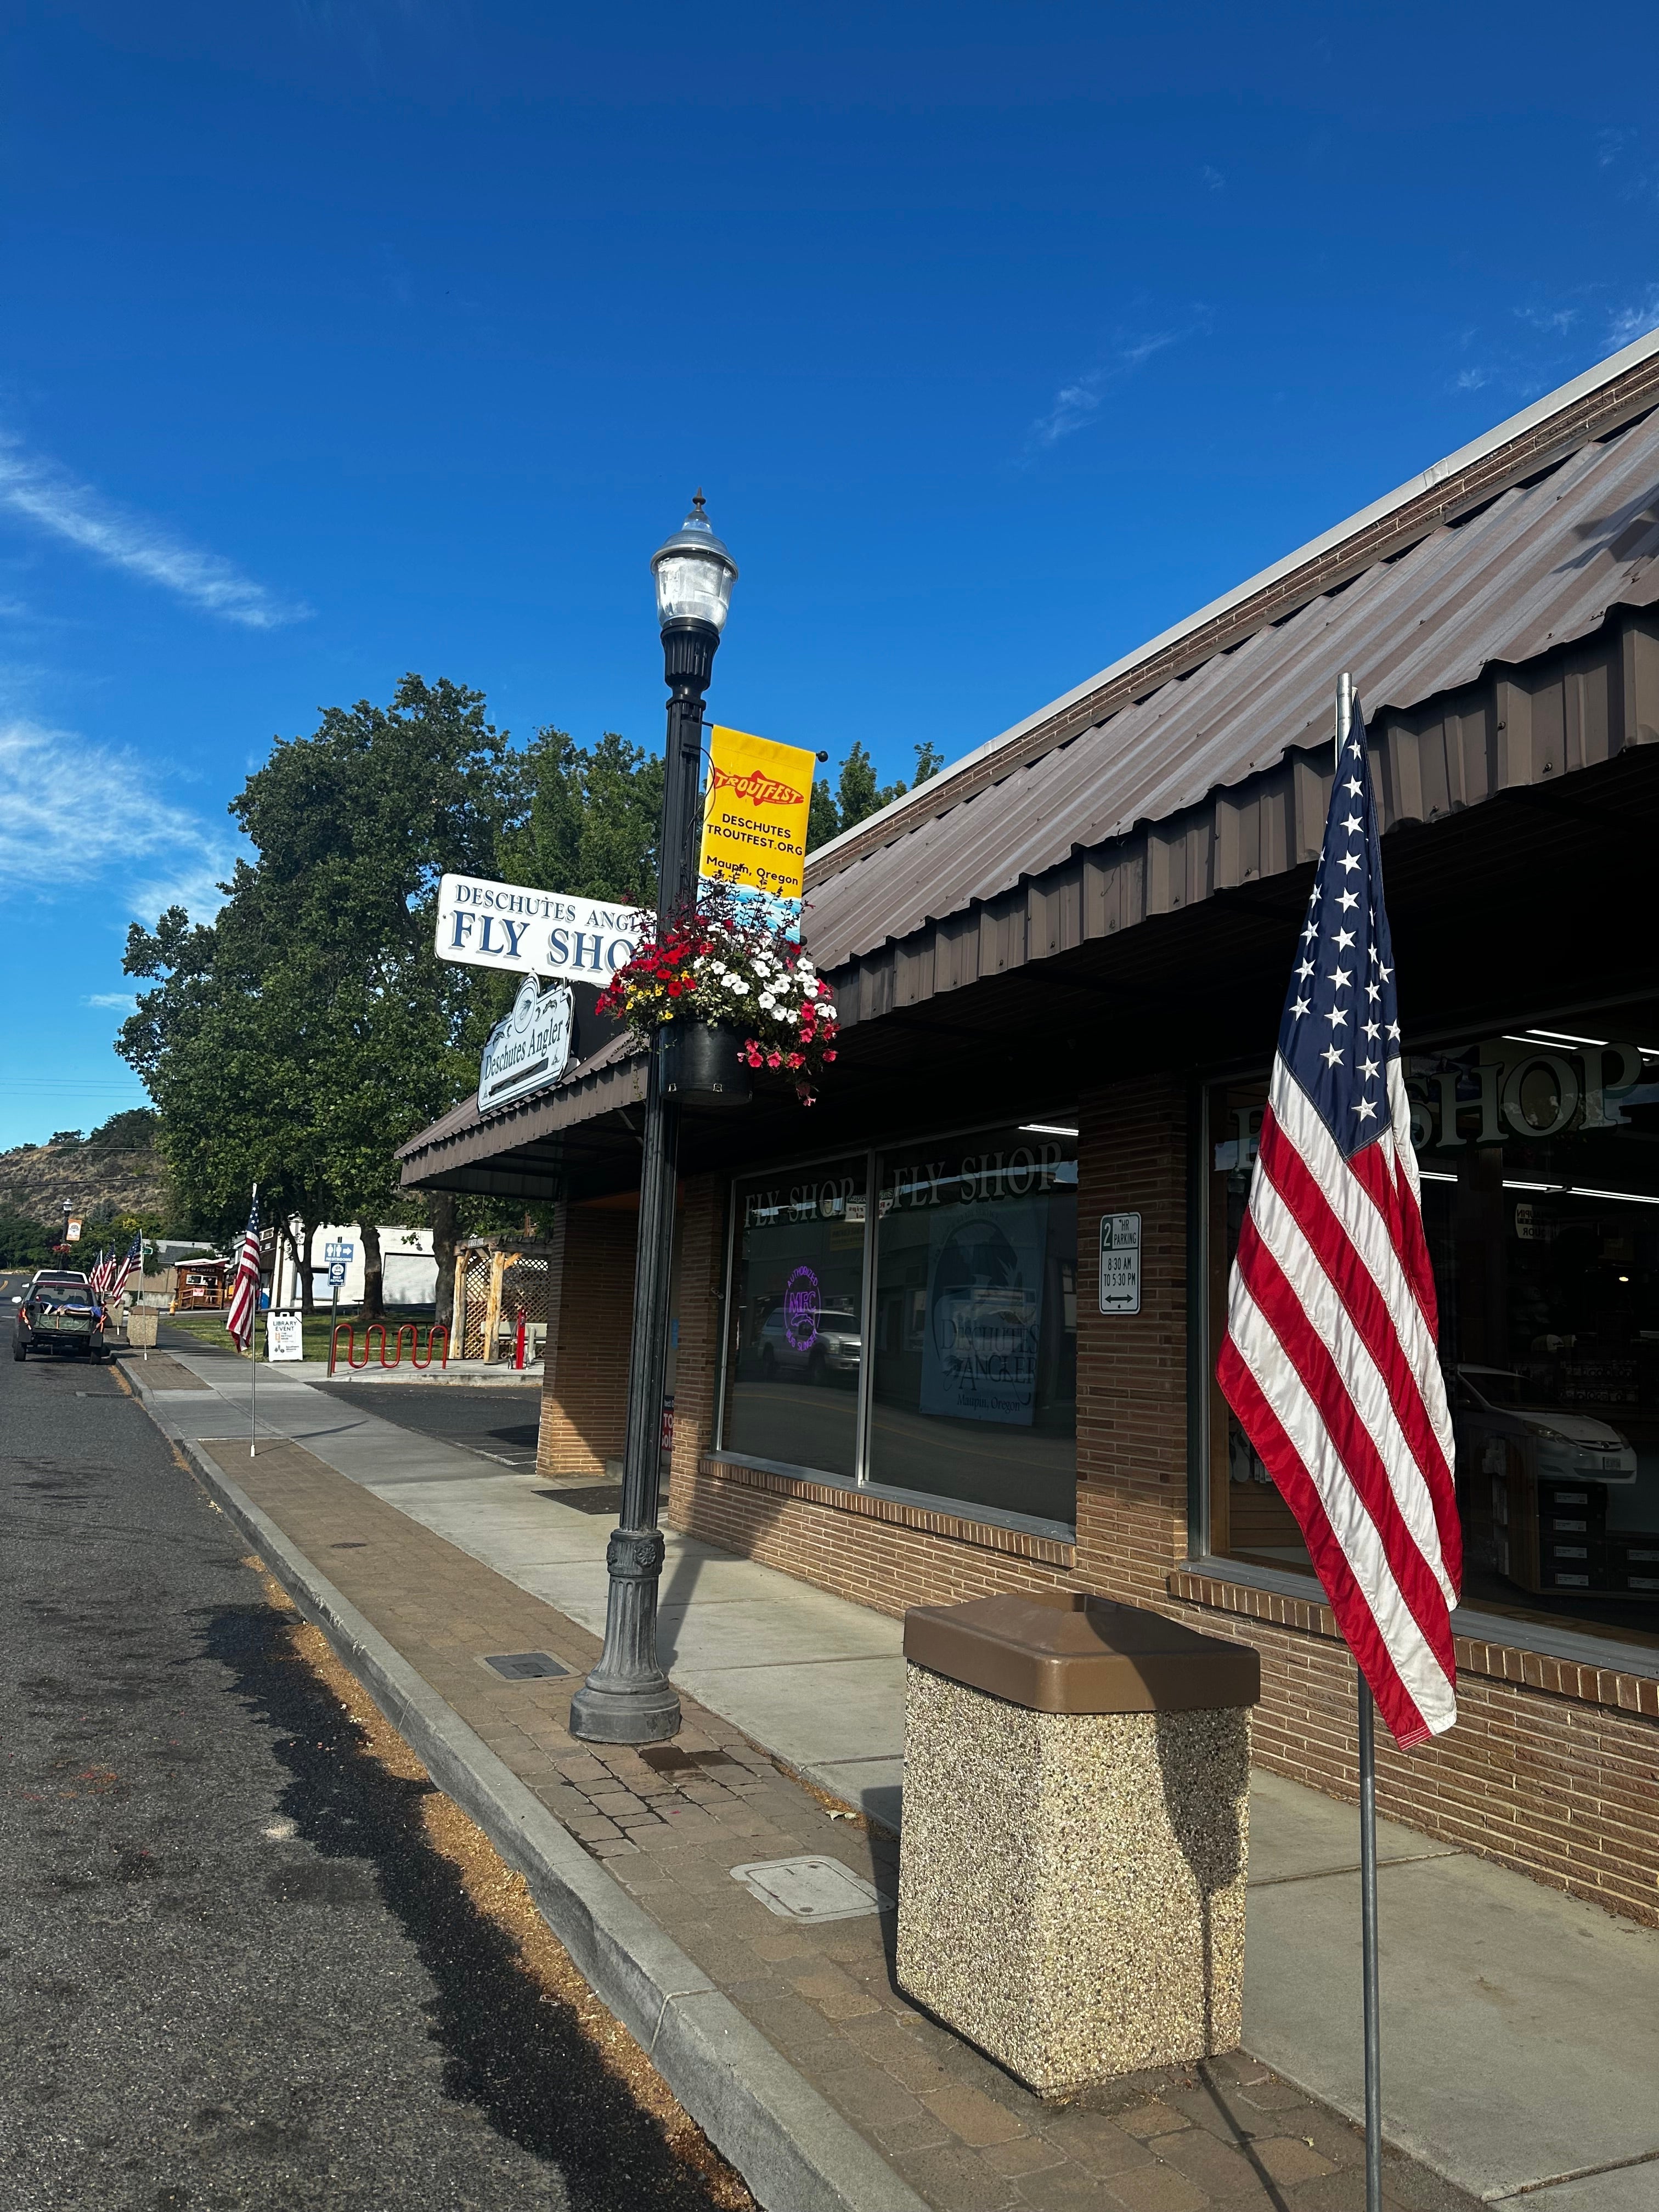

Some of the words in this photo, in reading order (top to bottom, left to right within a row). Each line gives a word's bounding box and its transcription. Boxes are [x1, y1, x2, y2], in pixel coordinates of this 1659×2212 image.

[715, 772, 802, 804] TROUTFEST
[707, 824, 803, 856] TROUTFEST.ORG
[722, 813, 791, 838] DESCHUTES
[757, 867, 798, 885] Oregon
[456, 884, 576, 922] DESCHUTES
[587, 909, 642, 934] ANGL
[450, 910, 530, 958] FLY
[549, 928, 638, 972] SHO
[484, 1041, 525, 1081] Deschutes
[528, 1017, 563, 1058] Angler
[893, 1161, 947, 1208] FLY
[961, 1142, 1063, 1201] SHOP
[744, 1191, 780, 1228] FLY
[789, 1177, 855, 1222] SHOP
[1103, 1222, 1111, 1246] 2
[1121, 1219, 1129, 1231] HR
[1114, 1232, 1137, 1245] PARKING
[1104, 1274, 1110, 1286] TO
[1113, 1273, 1125, 1286] 5:30
[1128, 1272, 1136, 1285] PM
[1108, 1257, 1121, 1271] 8:30
[1123, 1257, 1131, 1270] AM
[789, 1291, 816, 1313] MFC
[940, 1319, 1040, 1354] DESCHUTES
[958, 1355, 1037, 1391] ANGLER
[991, 1397, 1020, 1414] Oregon
